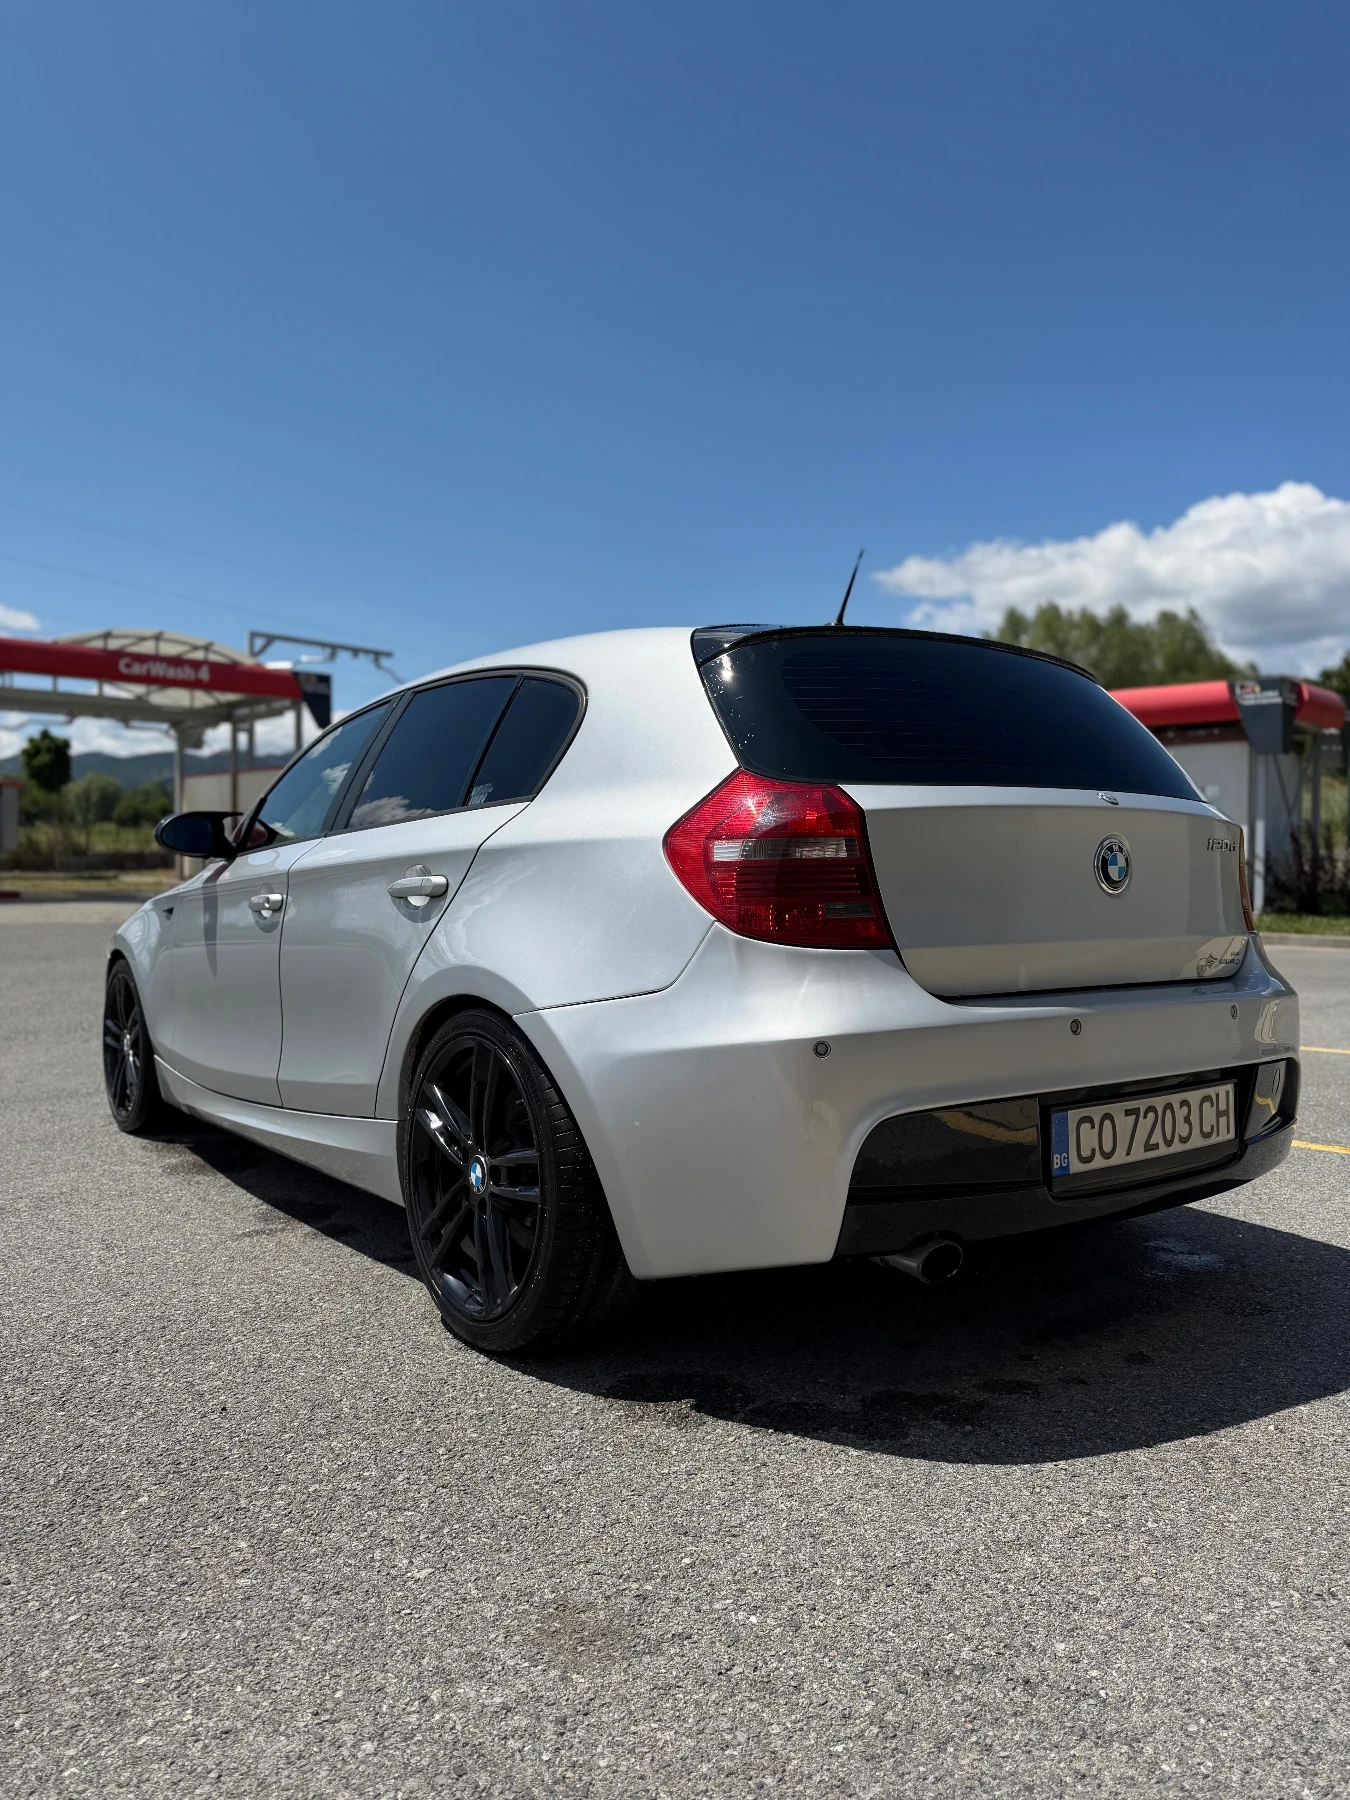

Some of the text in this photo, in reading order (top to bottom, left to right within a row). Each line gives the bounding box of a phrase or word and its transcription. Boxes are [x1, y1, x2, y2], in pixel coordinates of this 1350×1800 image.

[118, 657, 210, 683] CarWash 4
[1075, 1090, 1231, 1164] CO 7203 CH
[1053, 1153, 1068, 1168] BG
